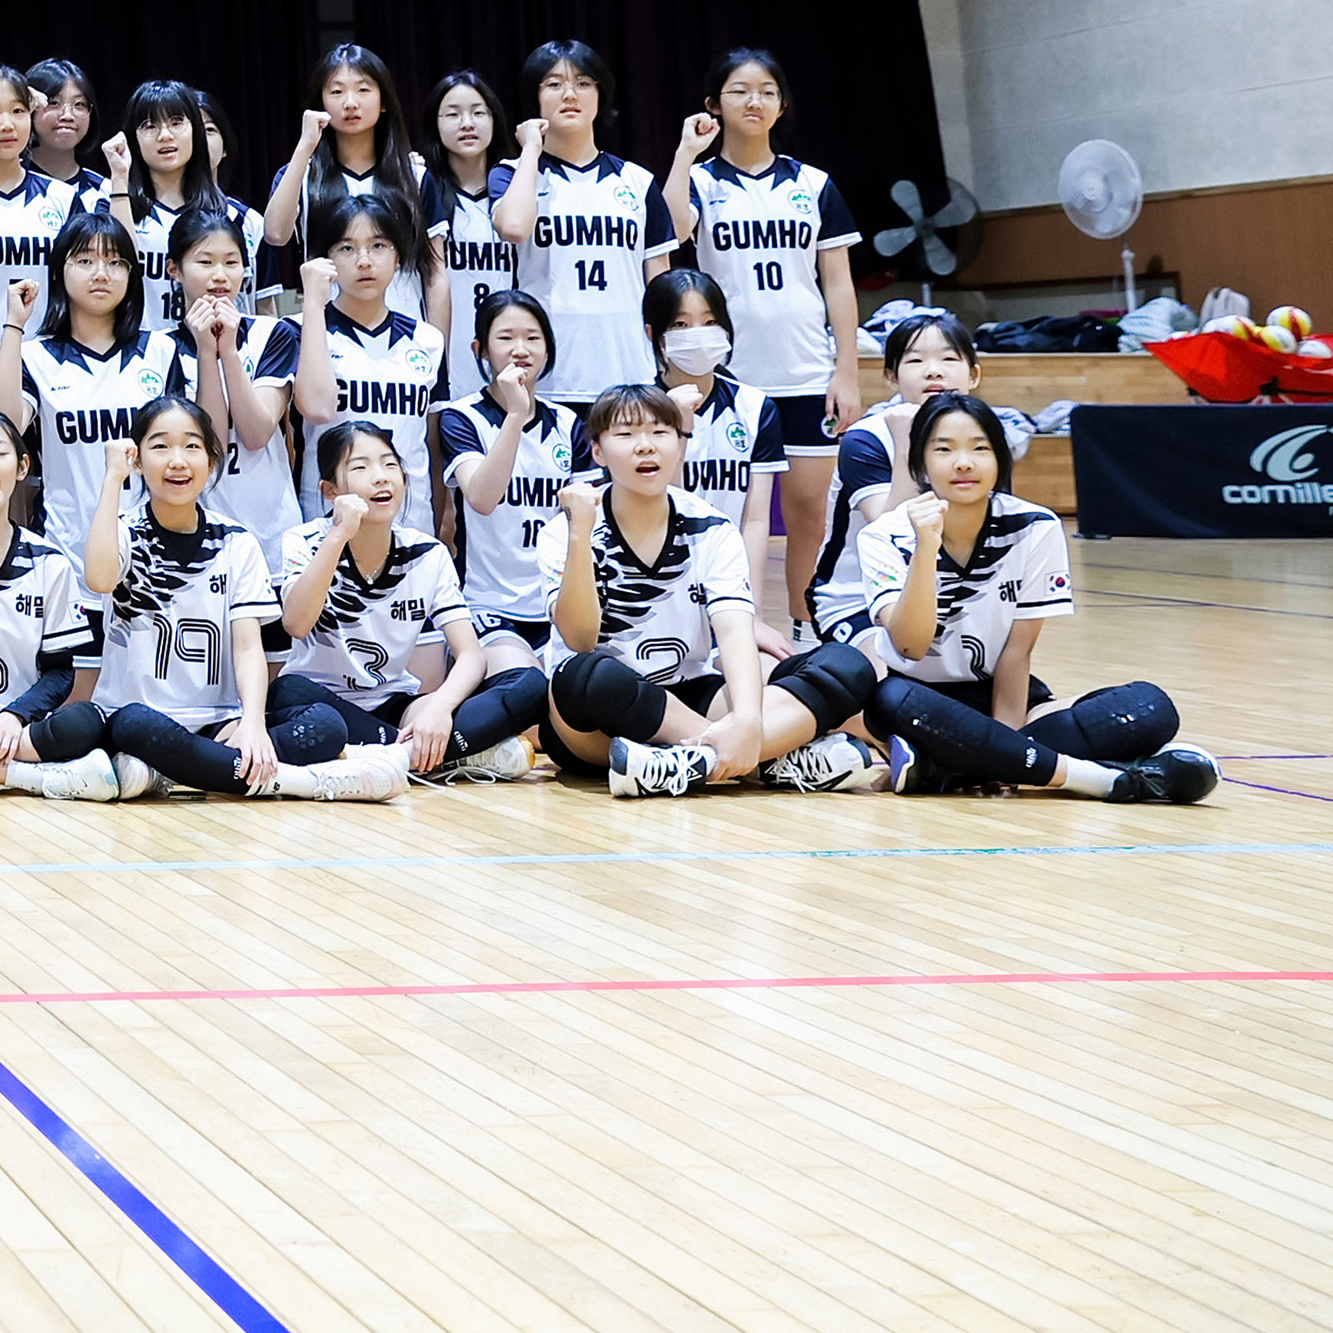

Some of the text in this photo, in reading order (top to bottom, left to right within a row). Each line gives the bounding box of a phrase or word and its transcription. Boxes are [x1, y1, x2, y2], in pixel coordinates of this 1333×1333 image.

[534, 214, 639, 252] GUMHO
[712, 218, 813, 253] GUMHO
[574, 259, 608, 292] 14
[753, 260, 784, 292] 10
[15, 592, 44, 618] 해밀
[390, 597, 426, 622] 해밀
[152, 616, 221, 686] 19
